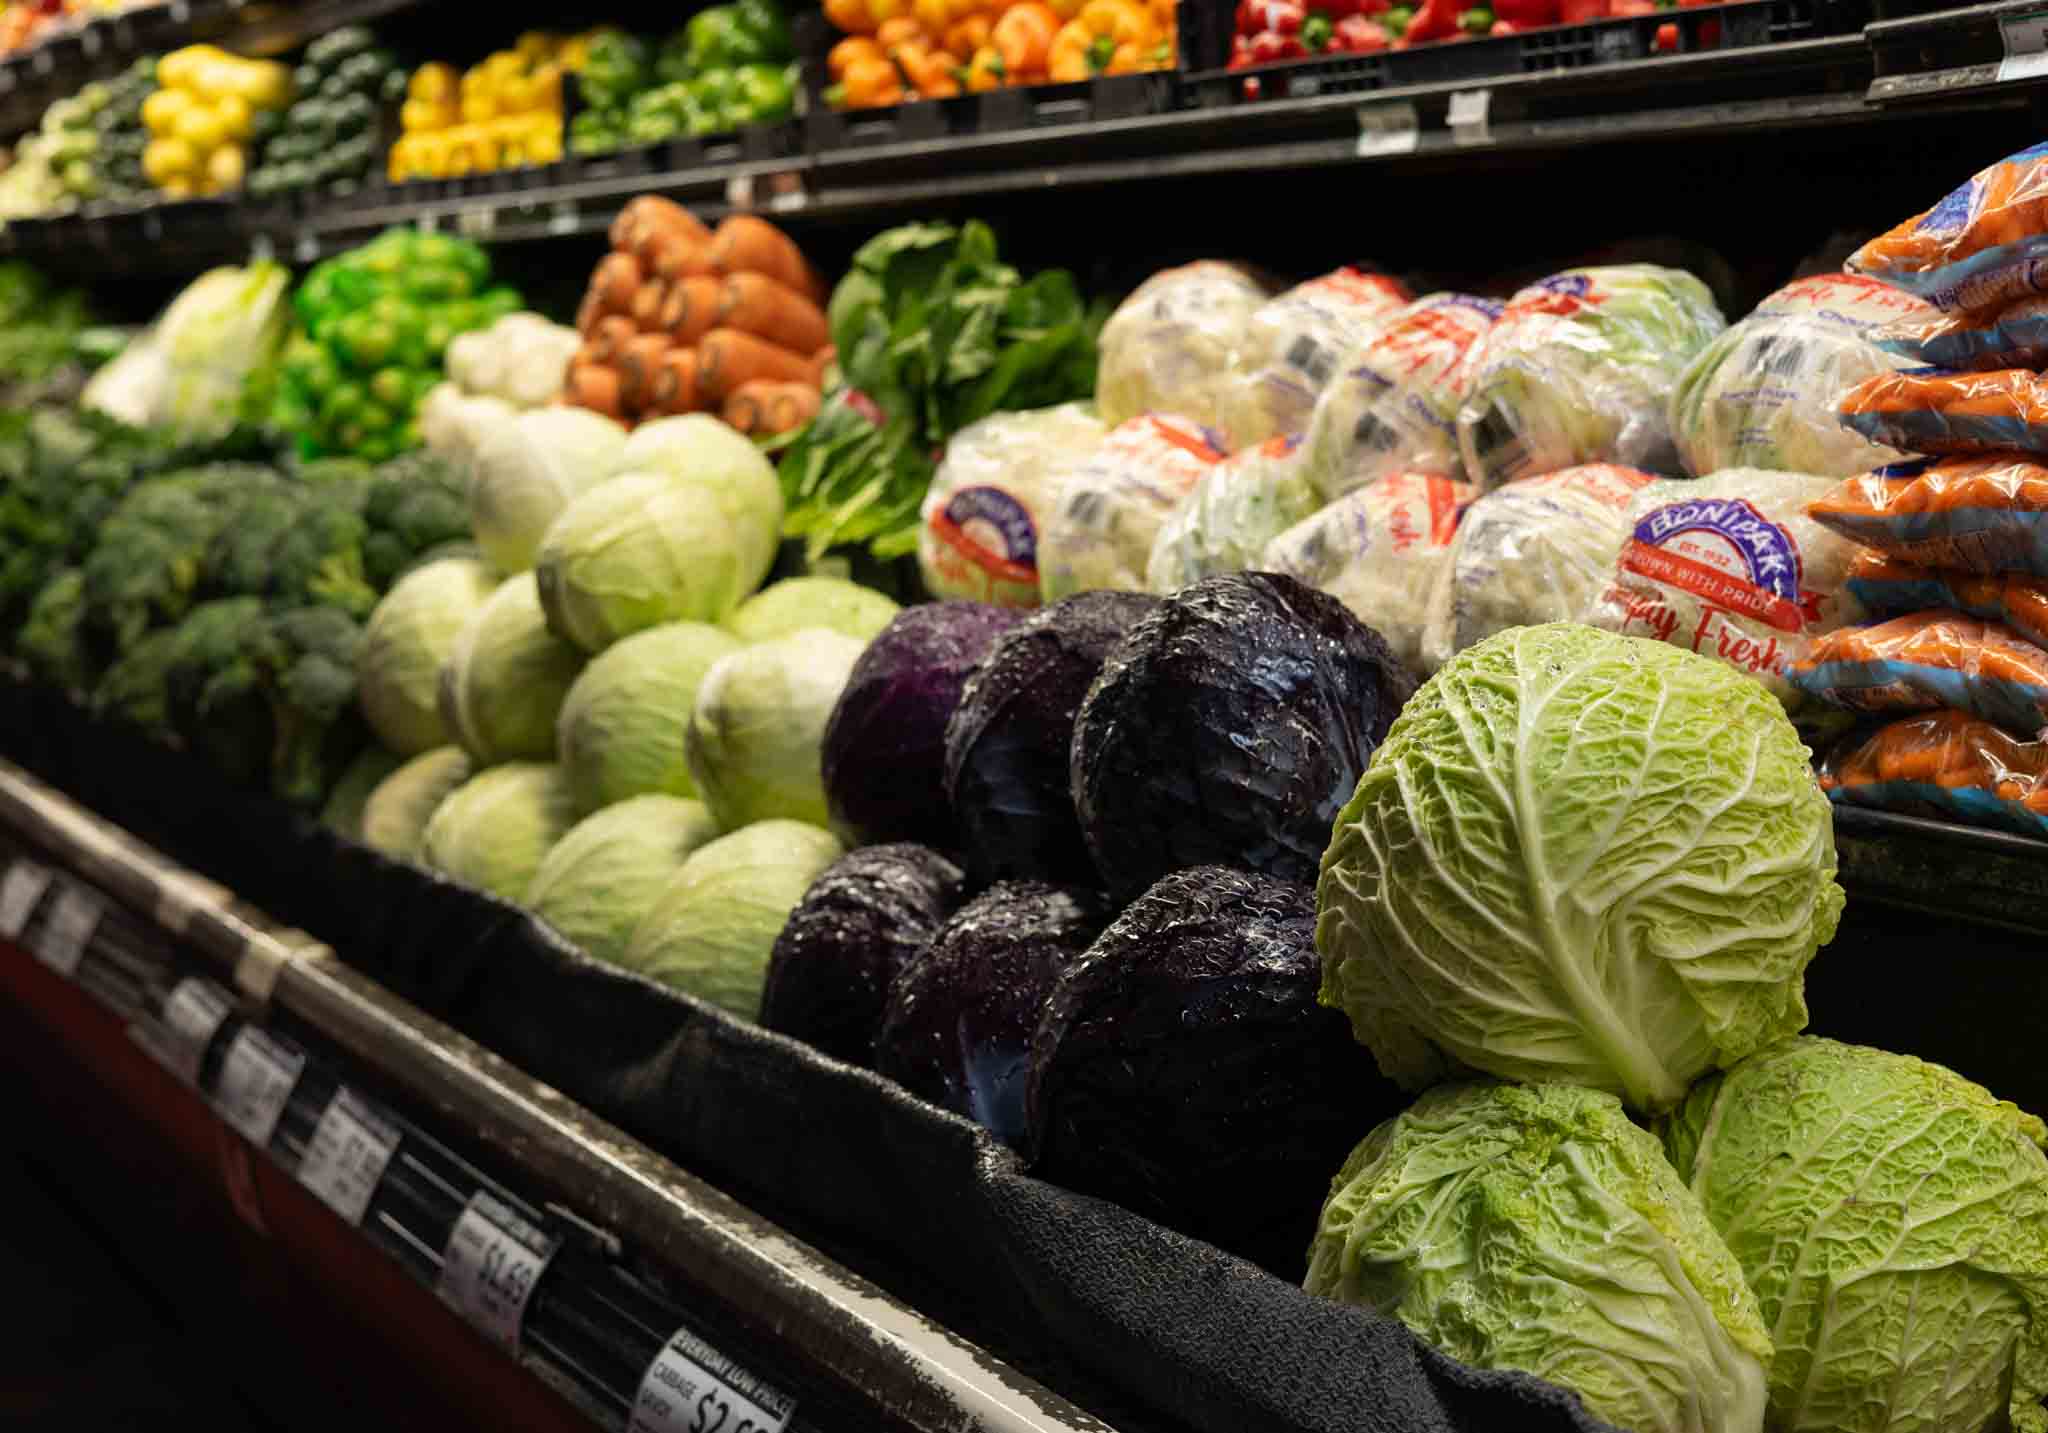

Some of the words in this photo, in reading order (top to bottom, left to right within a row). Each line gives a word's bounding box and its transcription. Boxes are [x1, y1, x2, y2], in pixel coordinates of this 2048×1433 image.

[1650, 503, 1788, 578] BONIPAK
[1678, 567, 1718, 592] WITH
[1721, 585, 1780, 615] PRIDE
[1692, 603, 1785, 677] Fresh
[653, 1361, 699, 1401] CABBAGE
